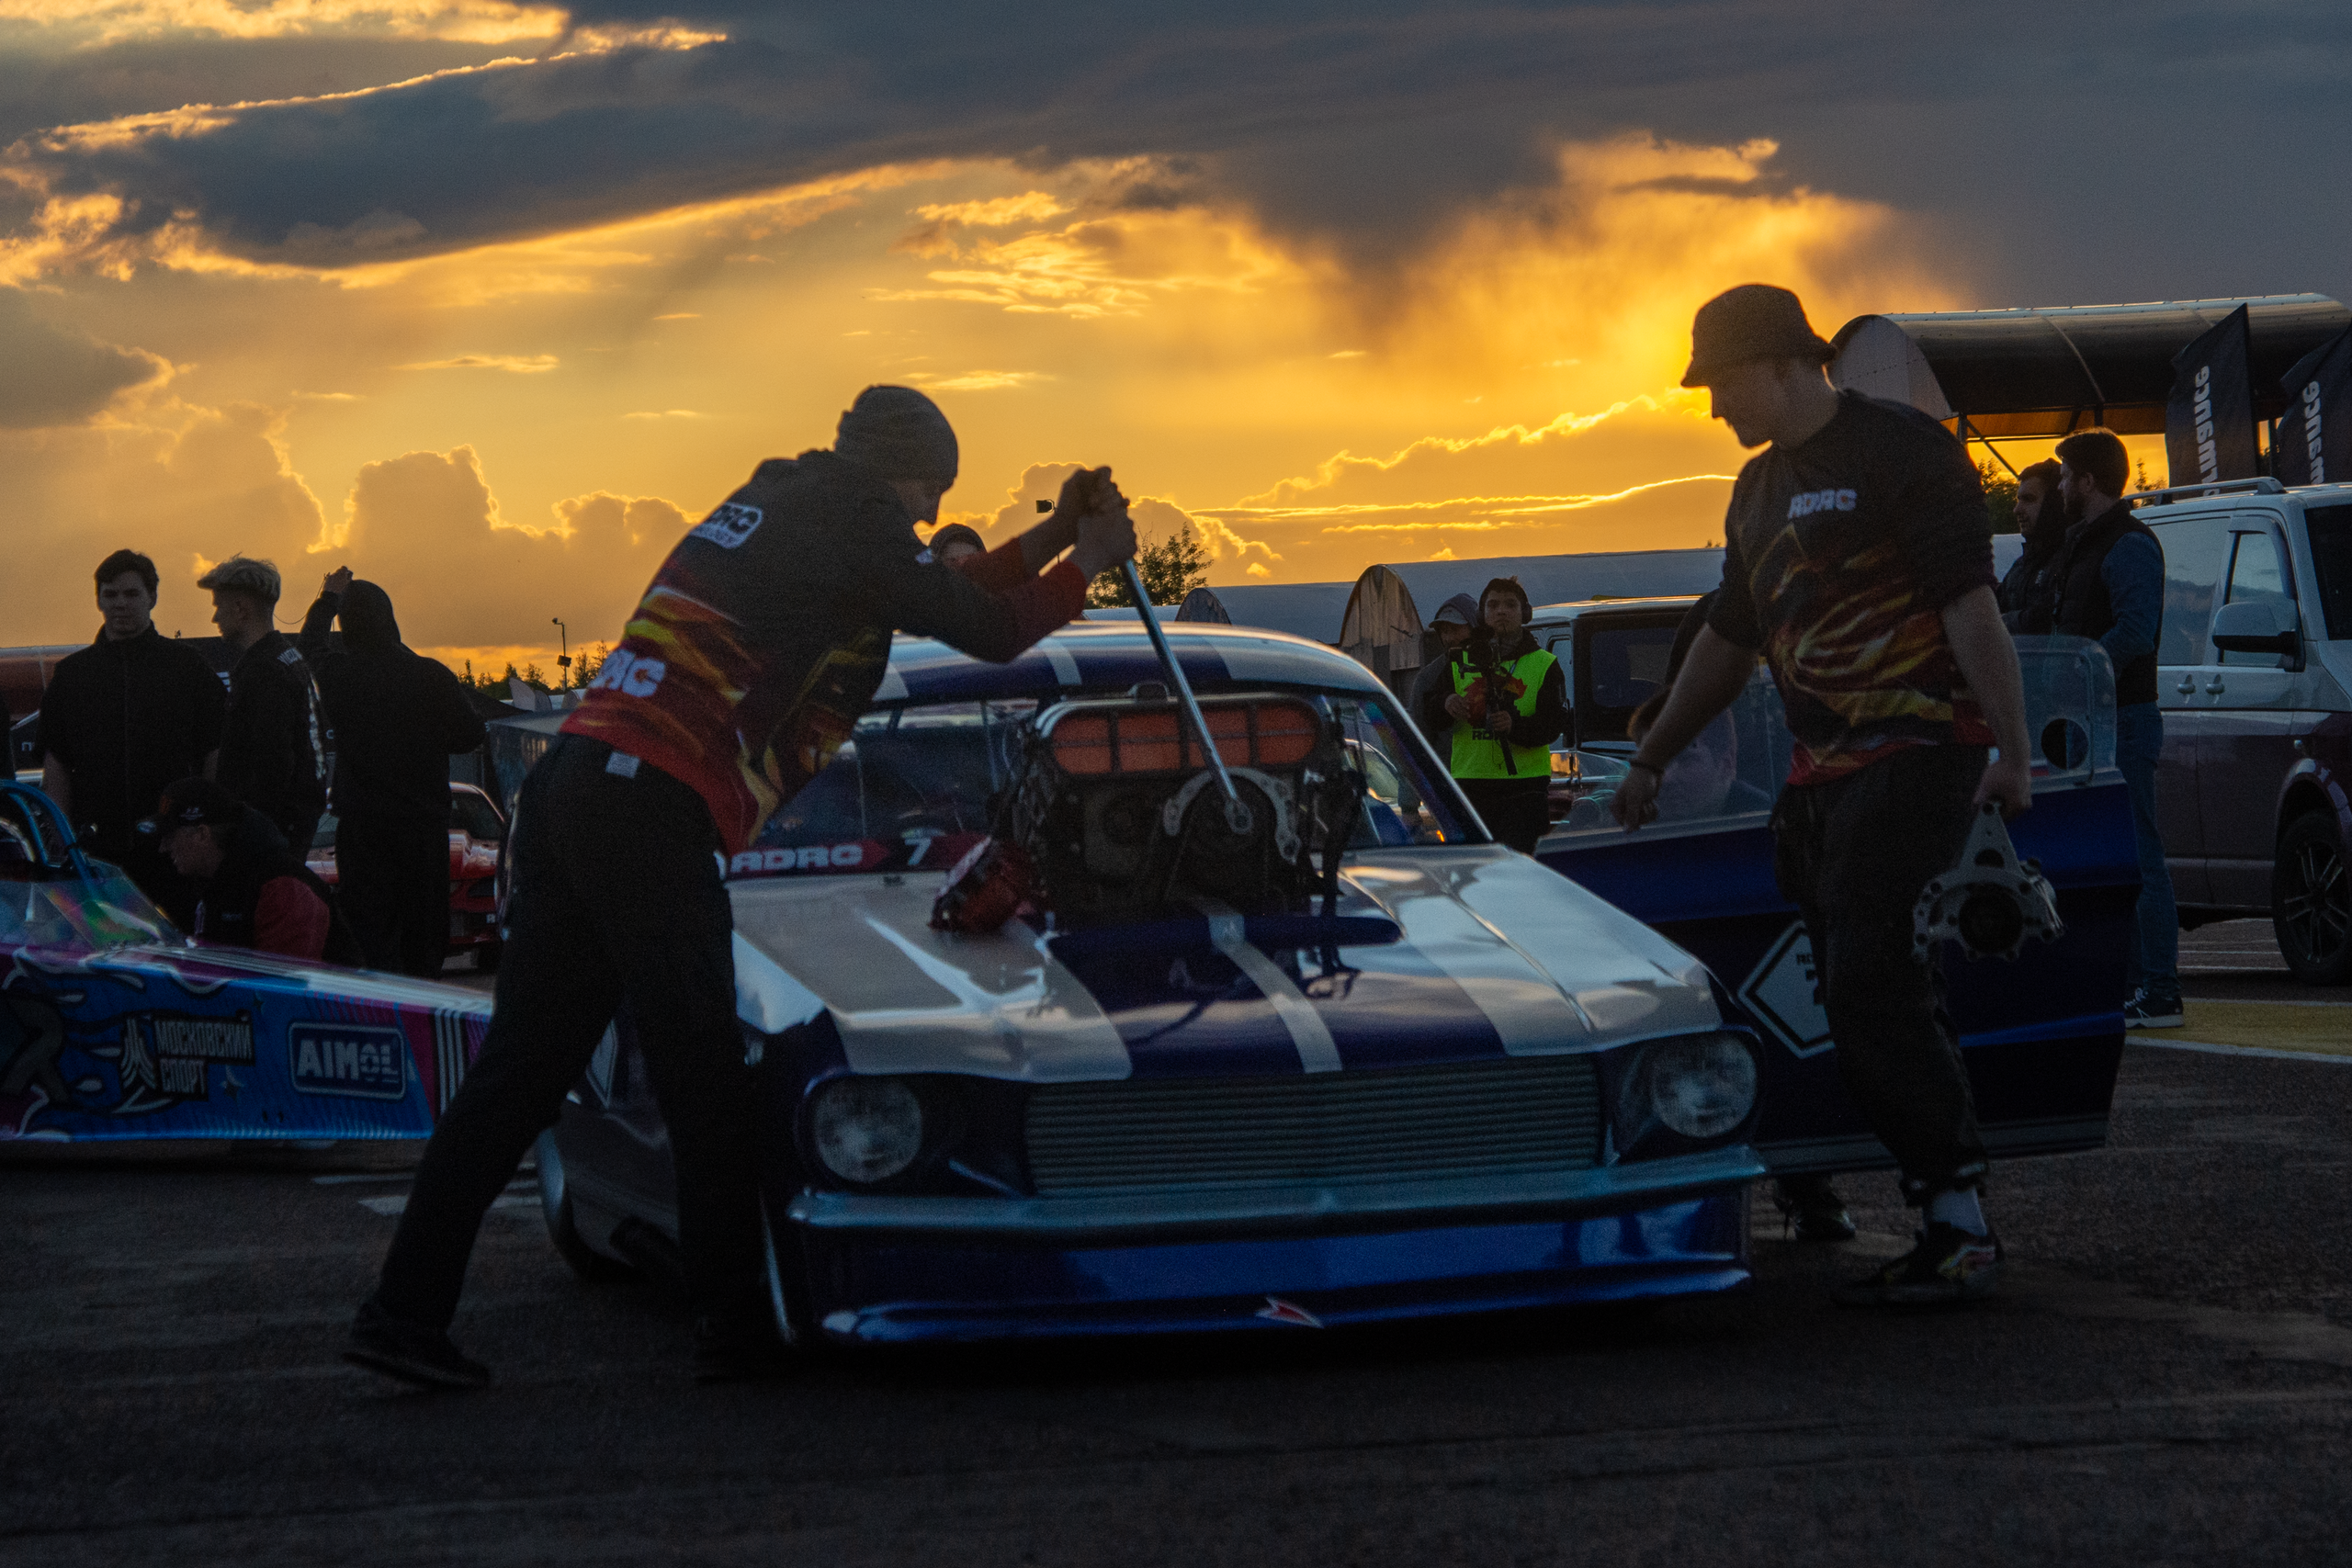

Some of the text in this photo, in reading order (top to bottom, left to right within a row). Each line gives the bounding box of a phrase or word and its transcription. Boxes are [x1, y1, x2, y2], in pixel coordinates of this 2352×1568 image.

[904, 837, 933, 866] 7
[159, 1058, 208, 1095] СПОРТ
[296, 1039, 400, 1084] AIMOL
